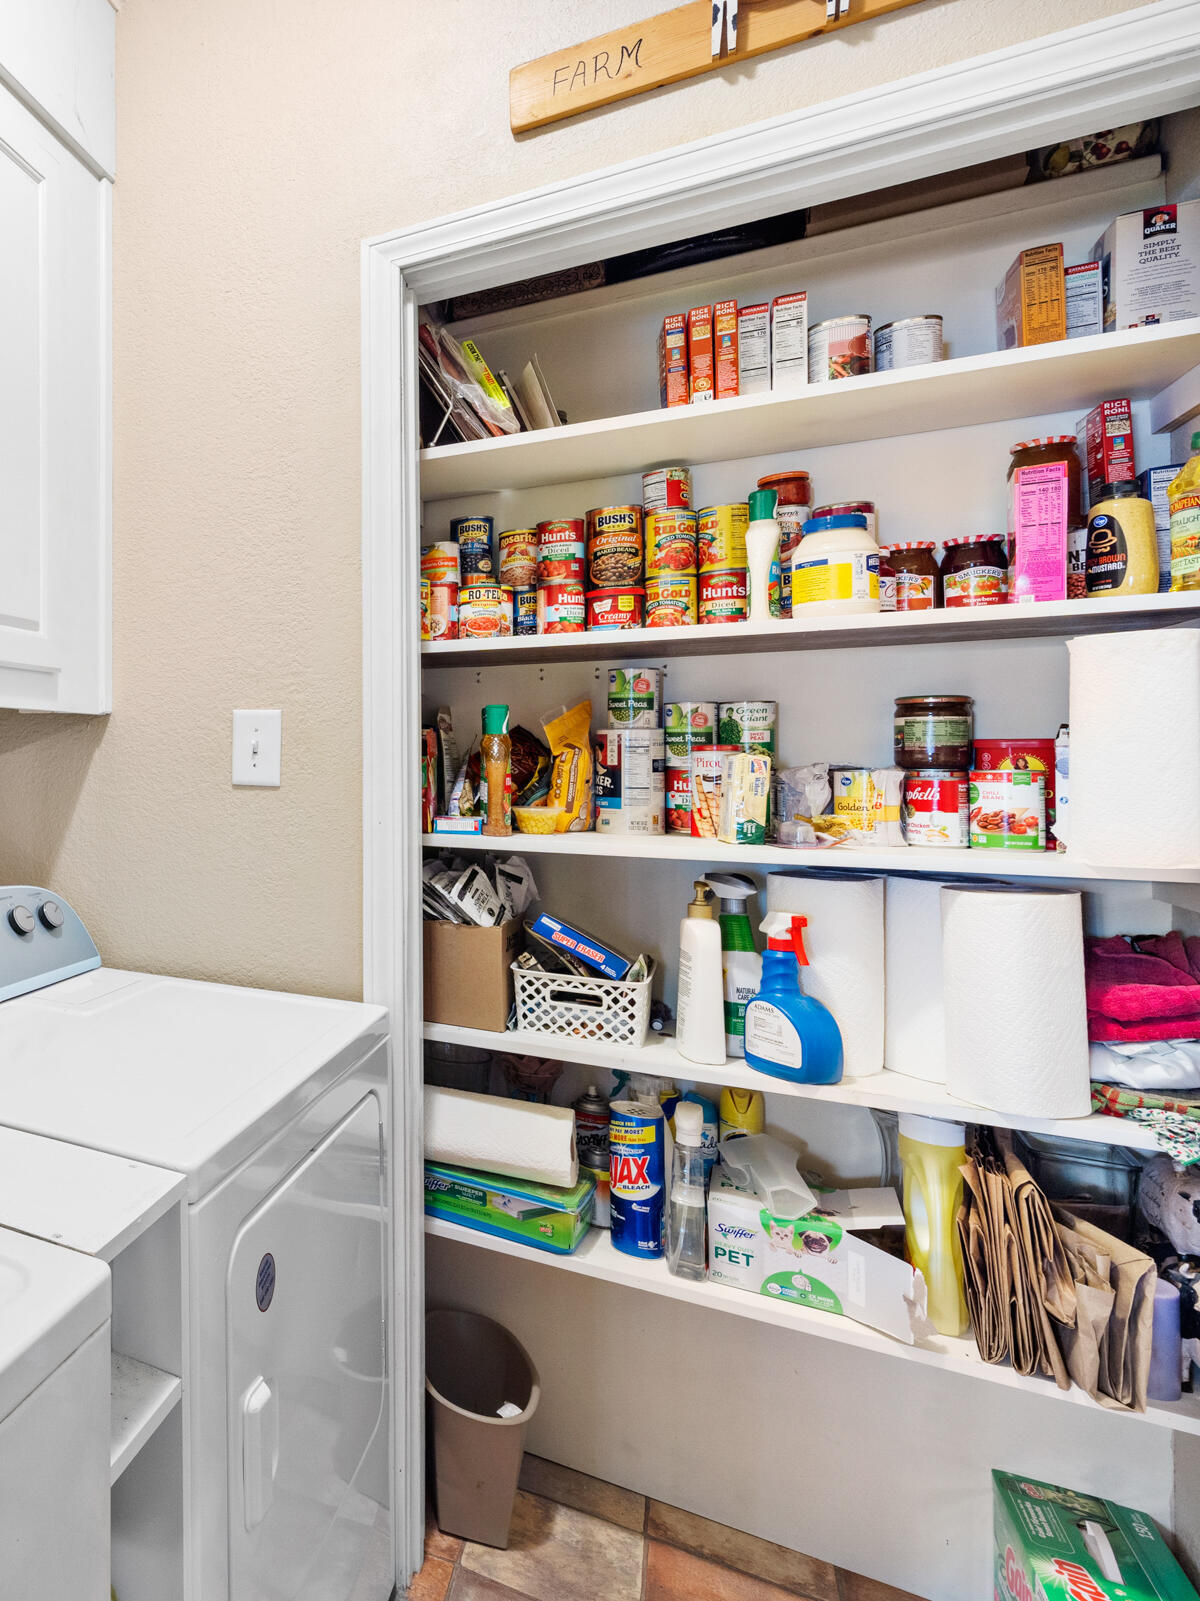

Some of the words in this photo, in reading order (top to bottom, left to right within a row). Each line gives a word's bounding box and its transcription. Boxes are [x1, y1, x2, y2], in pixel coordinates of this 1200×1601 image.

[553, 38, 643, 96] FARM
[1144, 222, 1177, 235] QUAKER
[1143, 238, 1176, 250] SIMPLY
[1138, 249, 1158, 258] THE
[1158, 244, 1182, 254] BEST
[716, 301, 735, 310] RICE
[691, 308, 709, 316] RICE
[665, 316, 683, 324] RICE
[1104, 400, 1128, 409] RICE
[1020, 468, 1045, 476] Nutrition
[1046, 466, 1061, 474] Facts
[598, 513, 635, 528] BUSH'S
[460, 524, 488, 535] BUSH'S
[654, 526, 677, 537] RED
[596, 533, 637, 546] Original
[547, 547, 570, 555] Diced
[596, 547, 616, 556] BAKED
[1099, 553, 1126, 564] BROWN
[1092, 562, 1123, 574] MUSTARD
[661, 588, 691, 599] GOLD
[659, 600, 686, 608] TOMATOES
[711, 600, 737, 609] Diced
[962, 596, 999, 604] Strawberry
[598, 612, 632, 623] Creamy
[627, 699, 648, 708] Peas
[735, 705, 768, 715] Green
[739, 713, 769, 722] Giant
[685, 734, 706, 743] Peas
[837, 801, 870, 812] Golden
[552, 931, 577, 949] SUPER
[575, 943, 606, 963] ERASER
[600, 964, 606, 972] 4
[736, 986, 757, 995] NATURAL
[754, 1003, 775, 1014] ADAMS
[454, 1184, 483, 1197] SWEEPER
[714, 1222, 757, 1240] Swiffer
[714, 1246, 755, 1267] PET
[711, 1269, 723, 1278] 20
